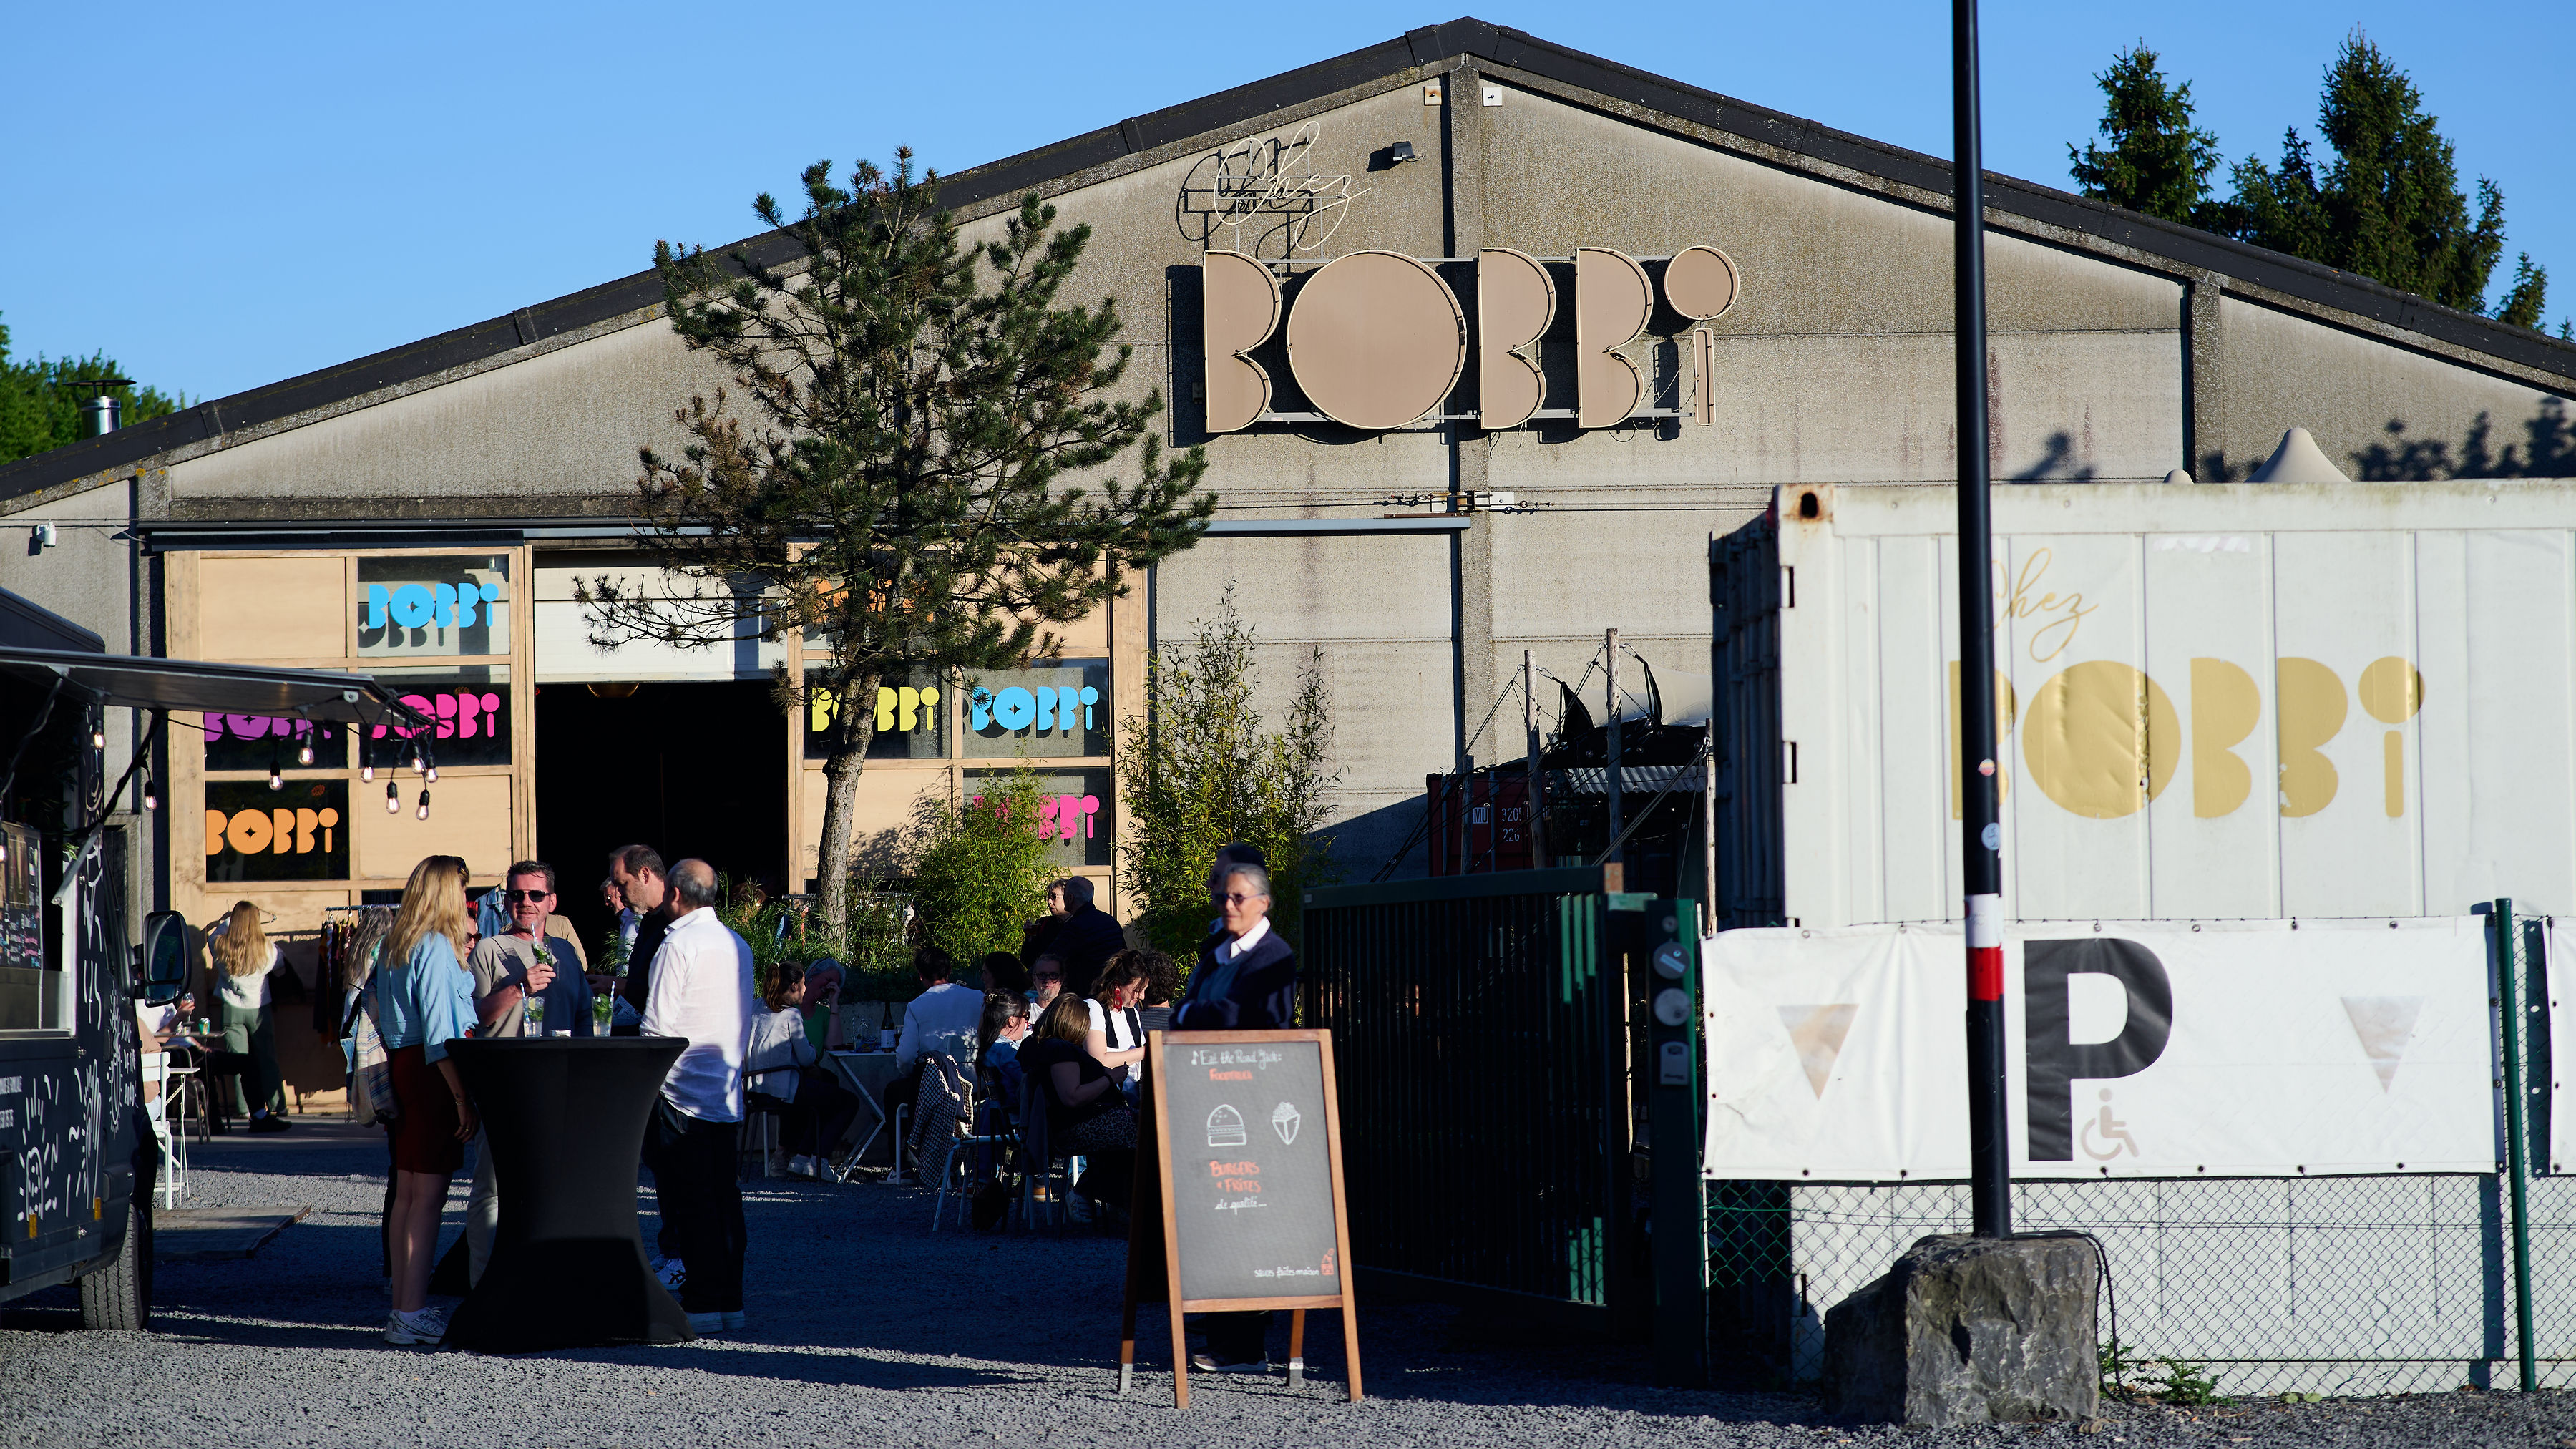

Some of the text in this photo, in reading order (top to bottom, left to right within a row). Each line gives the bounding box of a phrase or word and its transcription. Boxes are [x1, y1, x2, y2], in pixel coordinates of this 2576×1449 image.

[1213, 121, 1372, 250] Chez
[371, 693, 500, 739] OBBi
[811, 686, 940, 732] BBBi
[2024, 937, 2174, 1162] P
